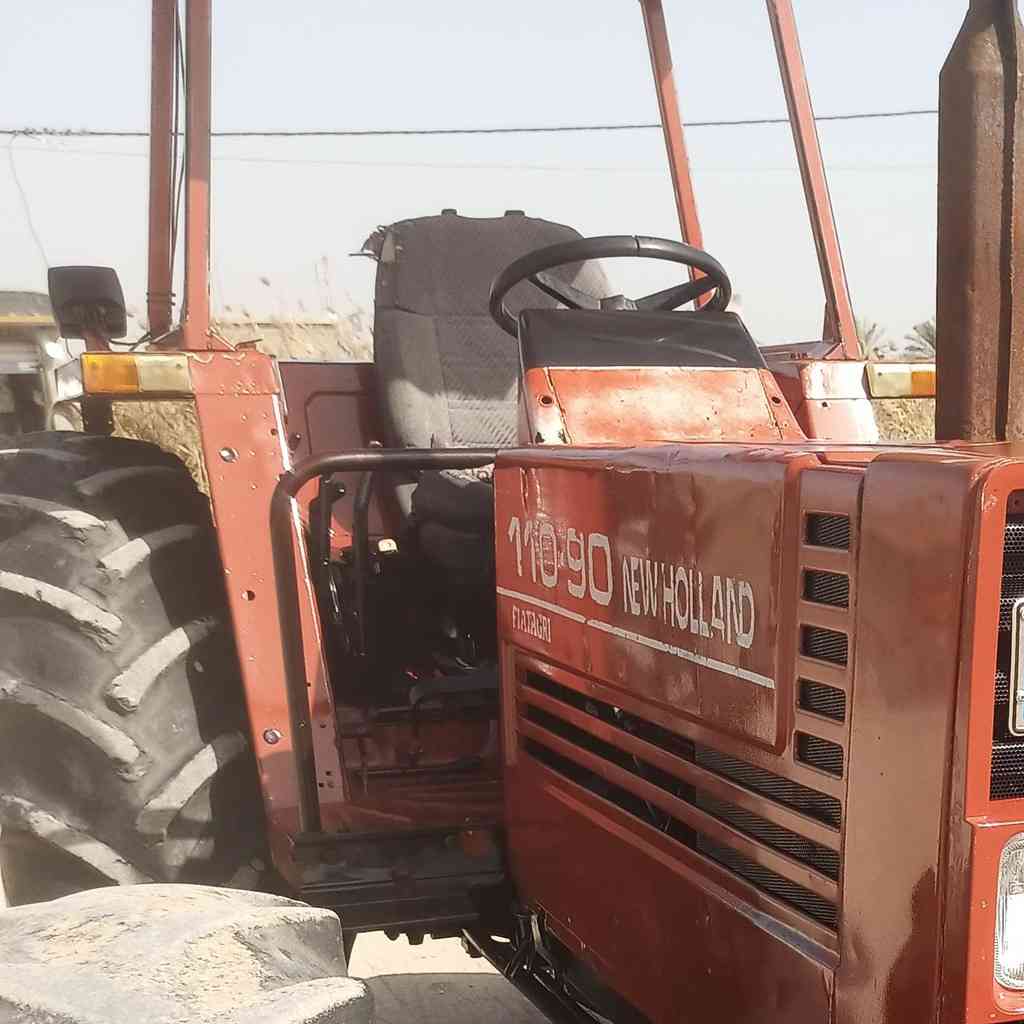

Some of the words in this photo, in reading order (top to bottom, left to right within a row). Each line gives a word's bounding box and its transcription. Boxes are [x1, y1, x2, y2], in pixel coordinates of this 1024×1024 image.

[512, 605, 552, 644] FIATAGRI
[622, 556, 658, 617] NEW
[661, 561, 756, 649] HOLLAND
